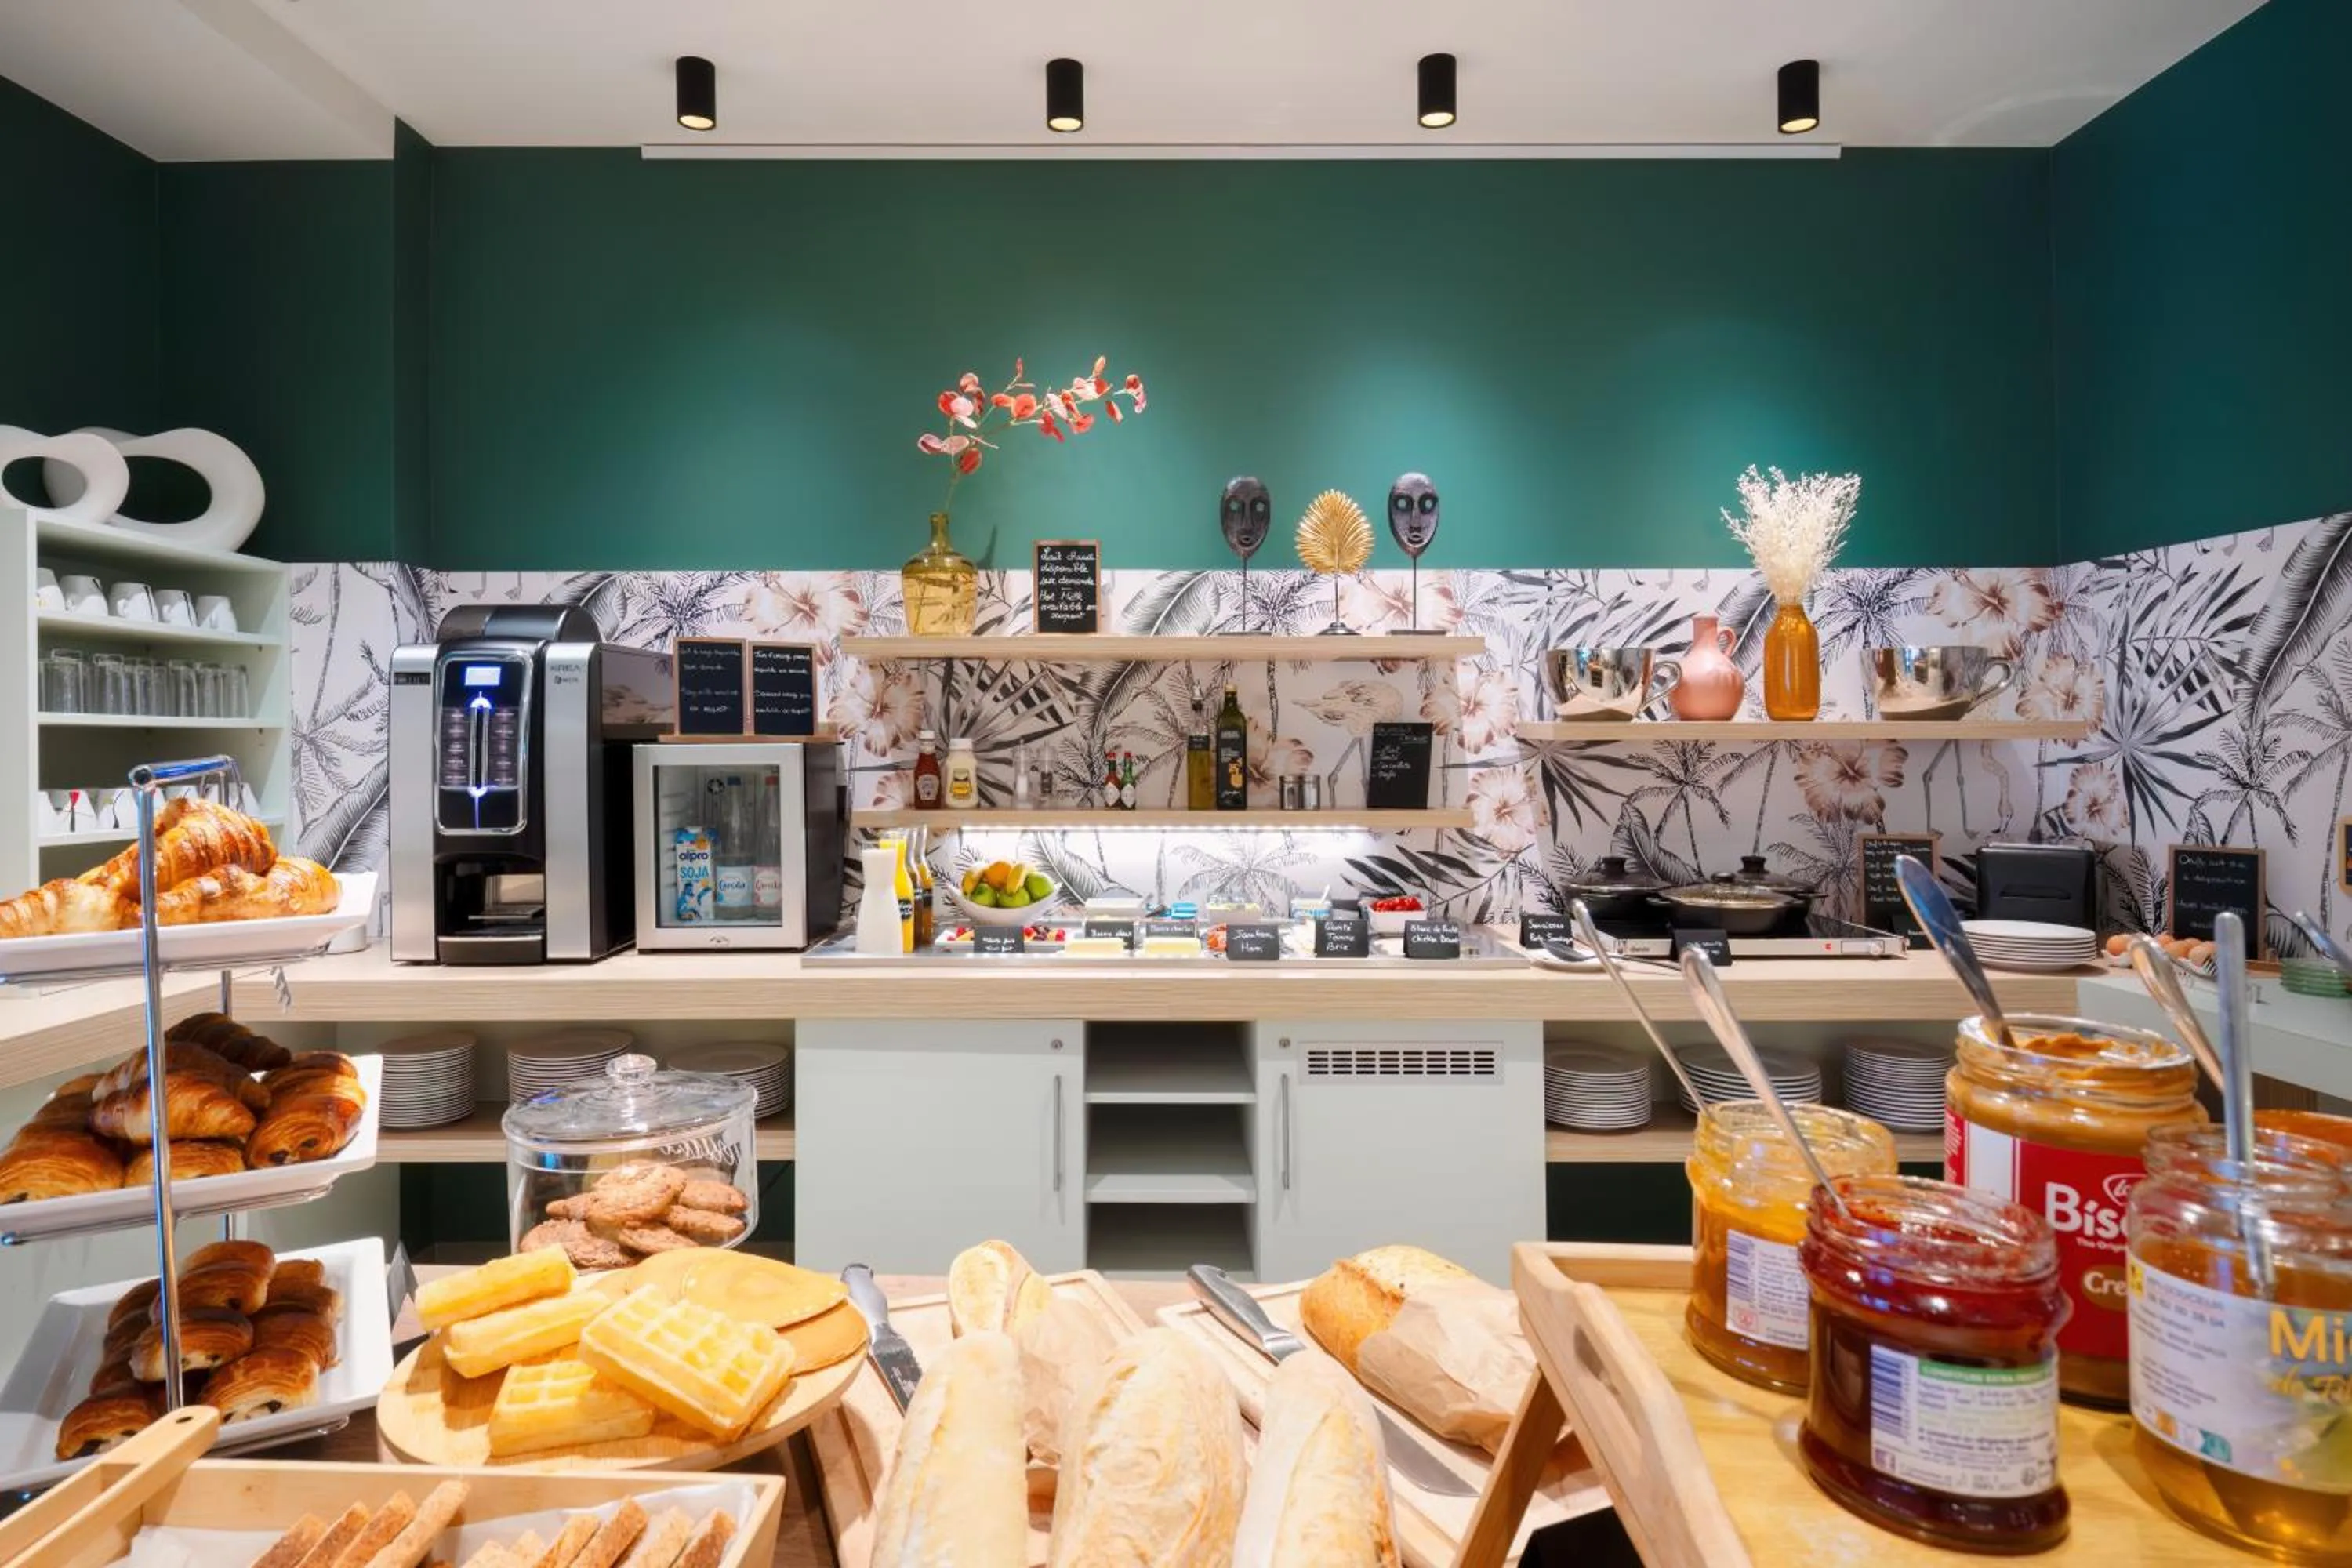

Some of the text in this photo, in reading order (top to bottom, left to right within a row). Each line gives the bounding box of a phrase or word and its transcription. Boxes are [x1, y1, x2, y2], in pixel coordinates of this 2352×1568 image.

[1066, 551, 1095, 561] chaud
[1040, 562, 1089, 575] disponible
[1058, 575, 1095, 586] demande
[1040, 590, 1054, 601] Hot
[679, 850, 709, 862] alpro
[680, 866, 710, 879] SOJA
[1241, 943, 1263, 953] Ham
[1326, 942, 1349, 952] Brie
[2270, 1309, 2352, 1364] Mi
